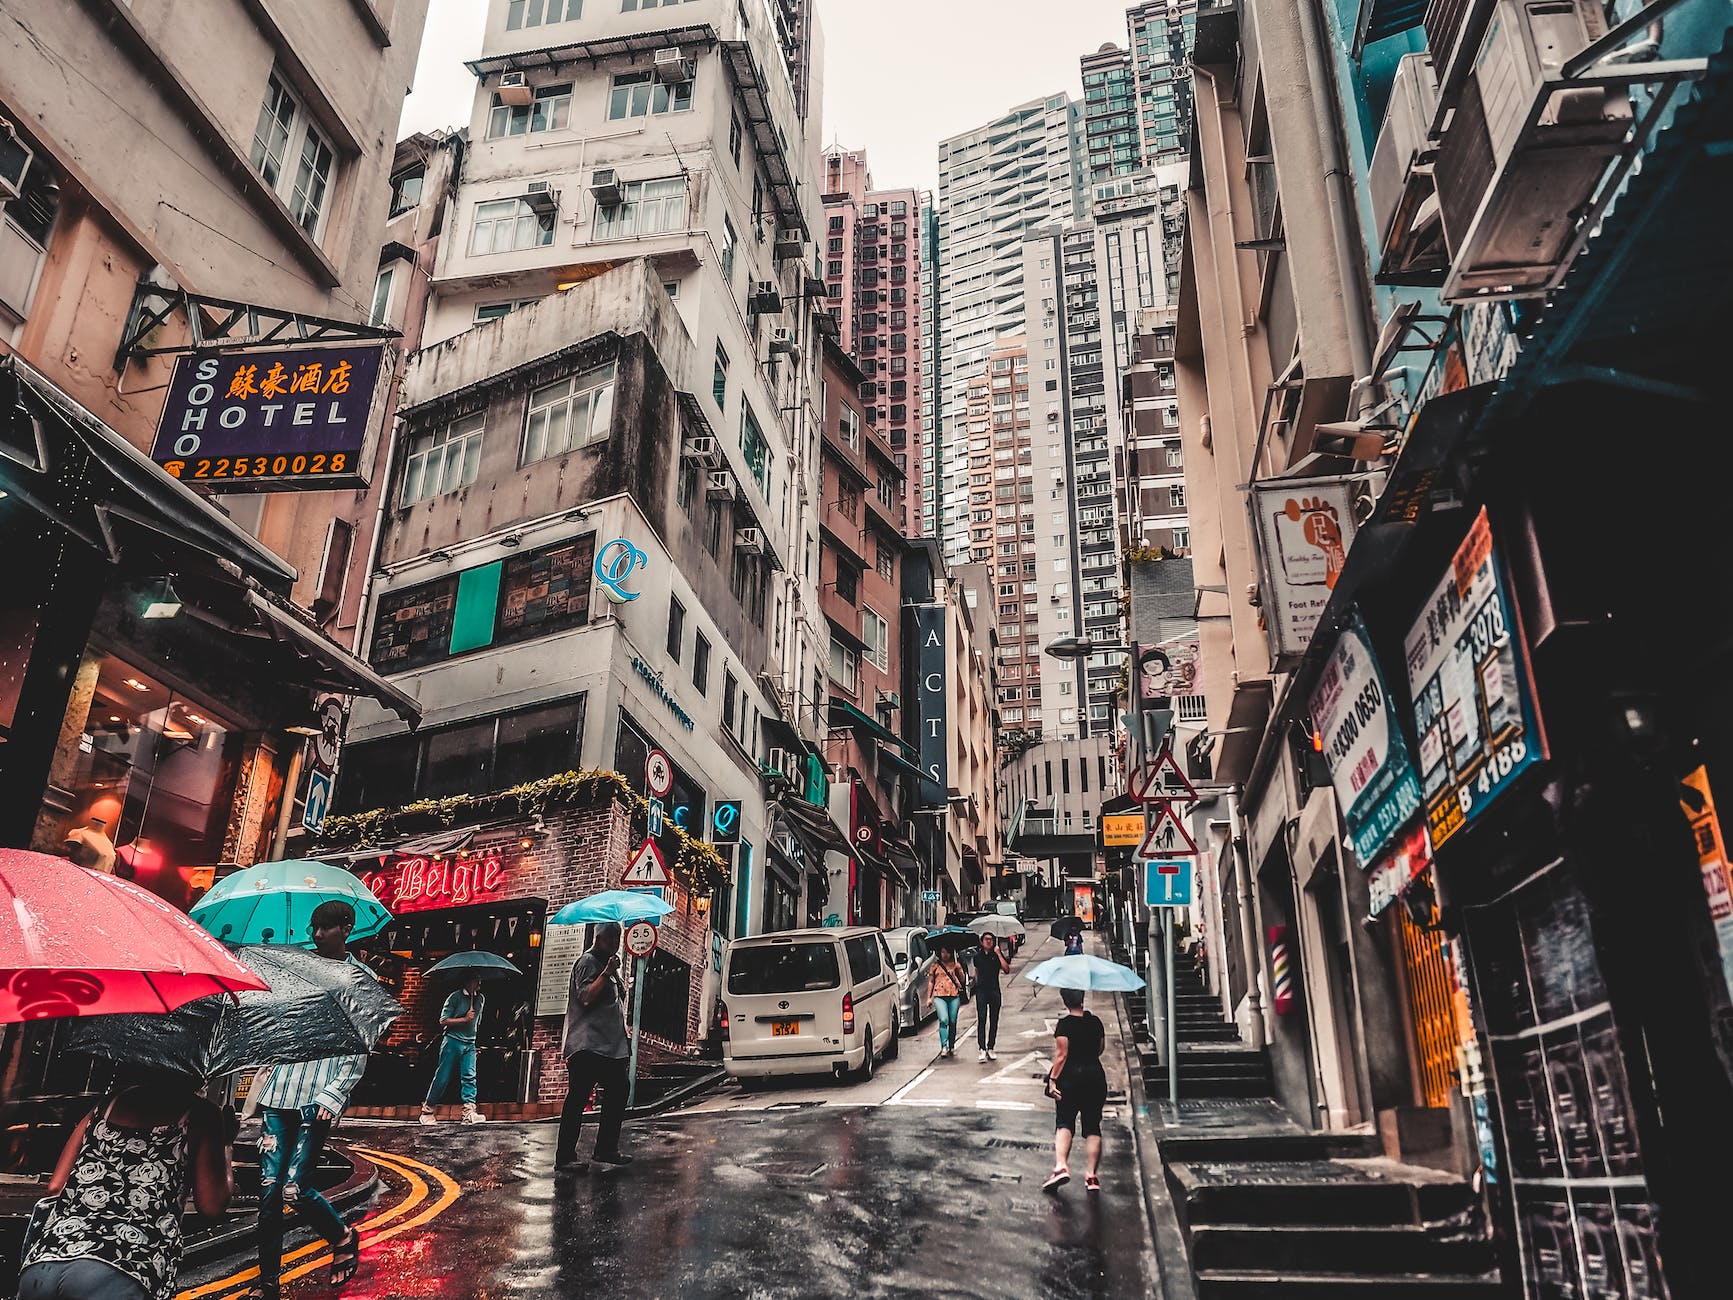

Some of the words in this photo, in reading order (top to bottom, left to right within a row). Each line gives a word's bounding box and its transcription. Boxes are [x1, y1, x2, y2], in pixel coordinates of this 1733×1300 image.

[225, 359, 353, 401] 蘇豪酒店
[173, 358, 219, 457] SOHO
[194, 453, 346, 478] 22530028
[1288, 601, 1308, 609] Foot
[924, 628, 942, 786] ACTS
[1354, 678, 1381, 728] 0650
[632, 928, 650, 939] 5.5
